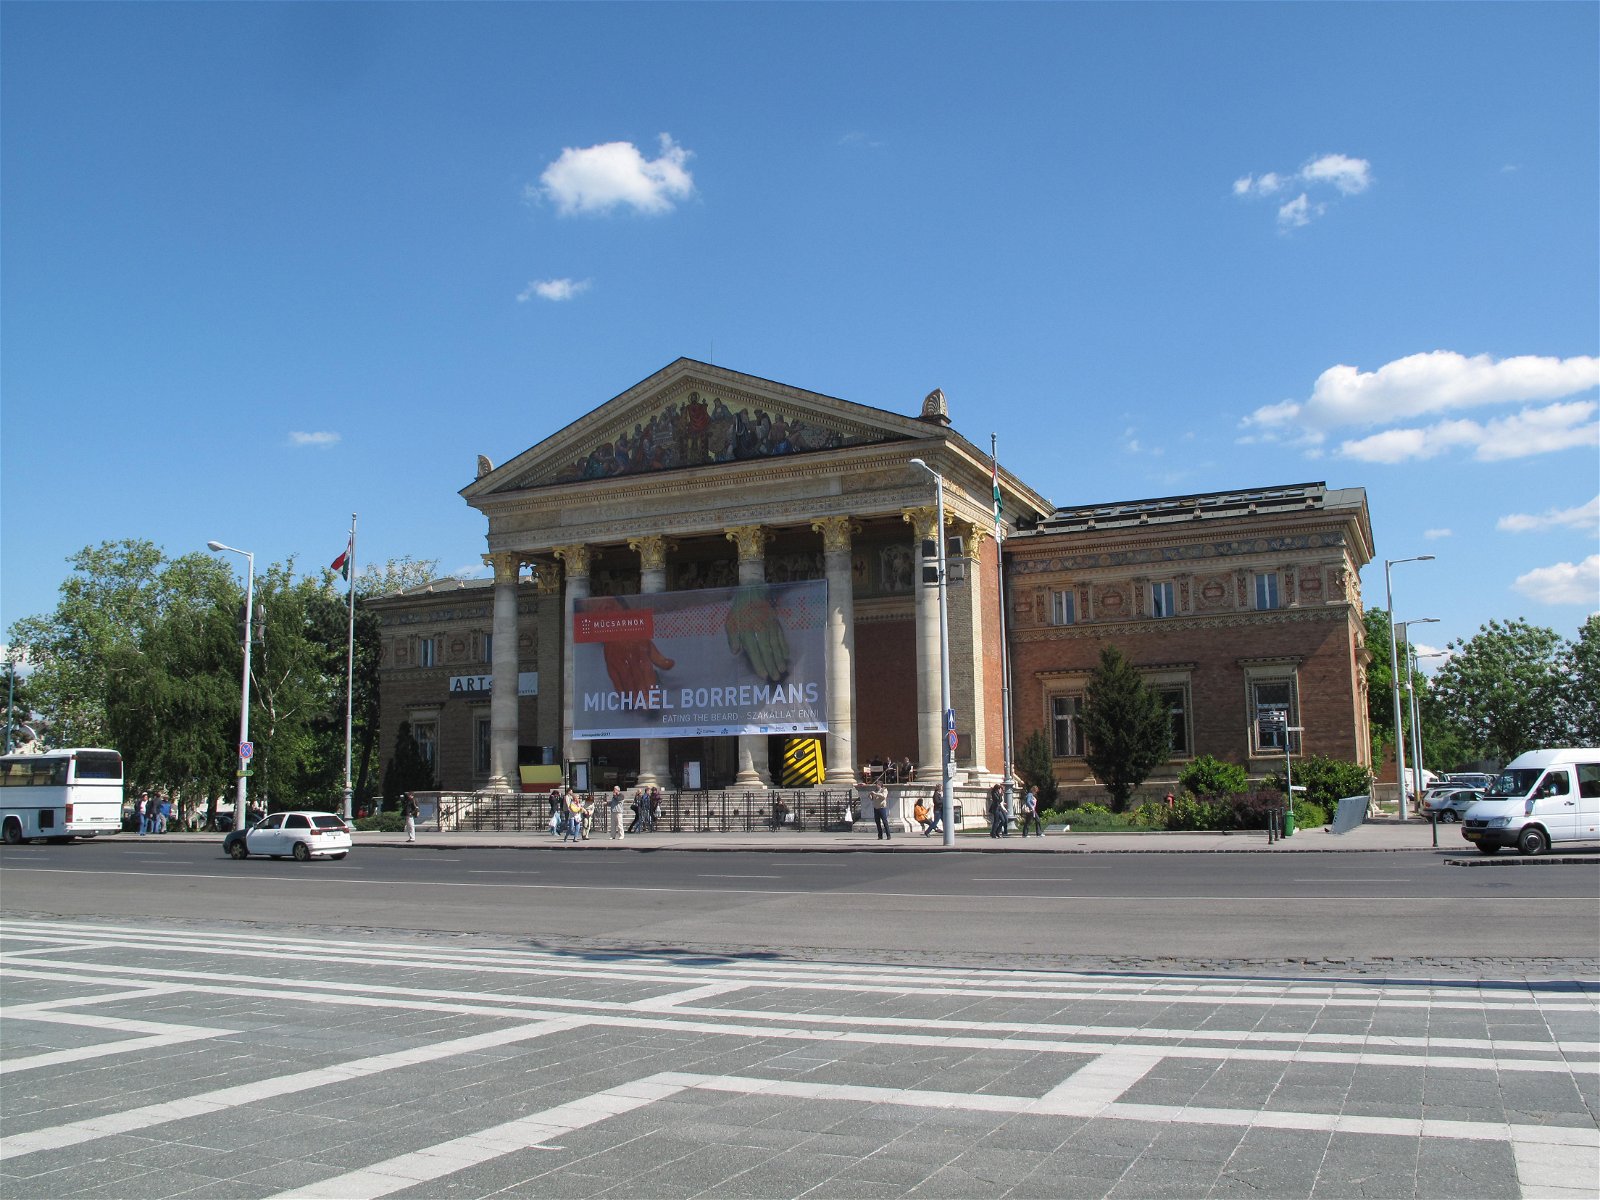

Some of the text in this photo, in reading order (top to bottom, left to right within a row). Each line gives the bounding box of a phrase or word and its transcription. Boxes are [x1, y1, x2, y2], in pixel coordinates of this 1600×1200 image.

[584, 682, 819, 712] MICHAËL BORREMANS
[662, 714, 691, 723] EATING
[693, 713, 709, 722] THE
[711, 712, 739, 721] BEARD
[798, 709, 819, 719] ENNI
